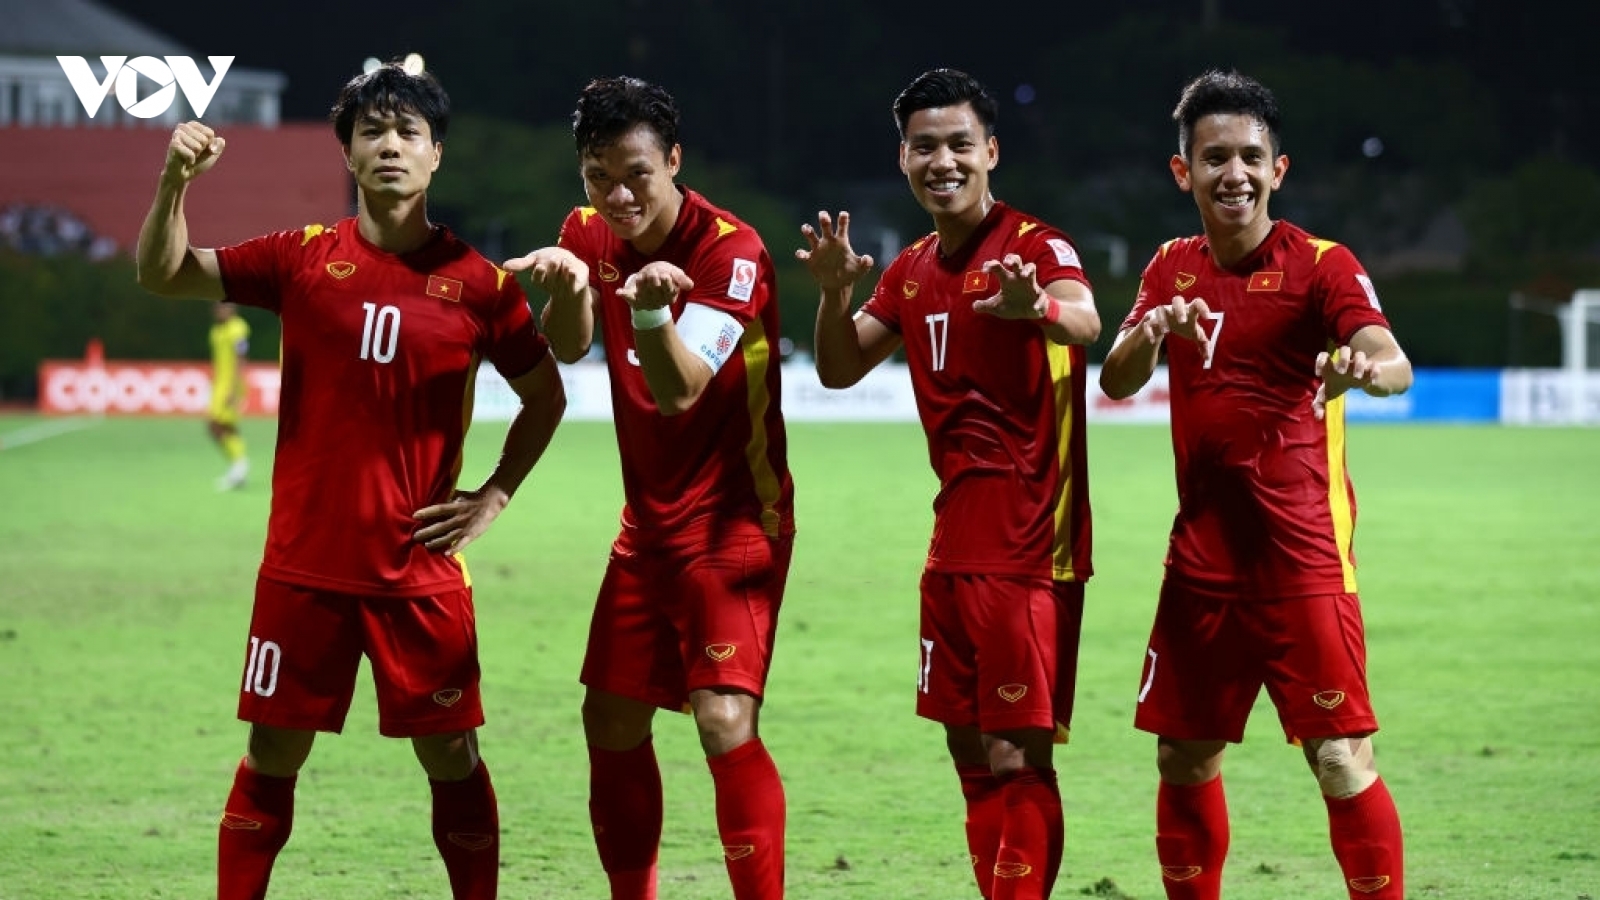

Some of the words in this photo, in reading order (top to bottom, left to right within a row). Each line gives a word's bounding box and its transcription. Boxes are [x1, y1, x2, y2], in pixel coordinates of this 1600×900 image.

[360, 301, 401, 364] 10
[925, 312, 949, 372] 17
[1202, 312, 1225, 370] 7
[244, 636, 281, 697] 10
